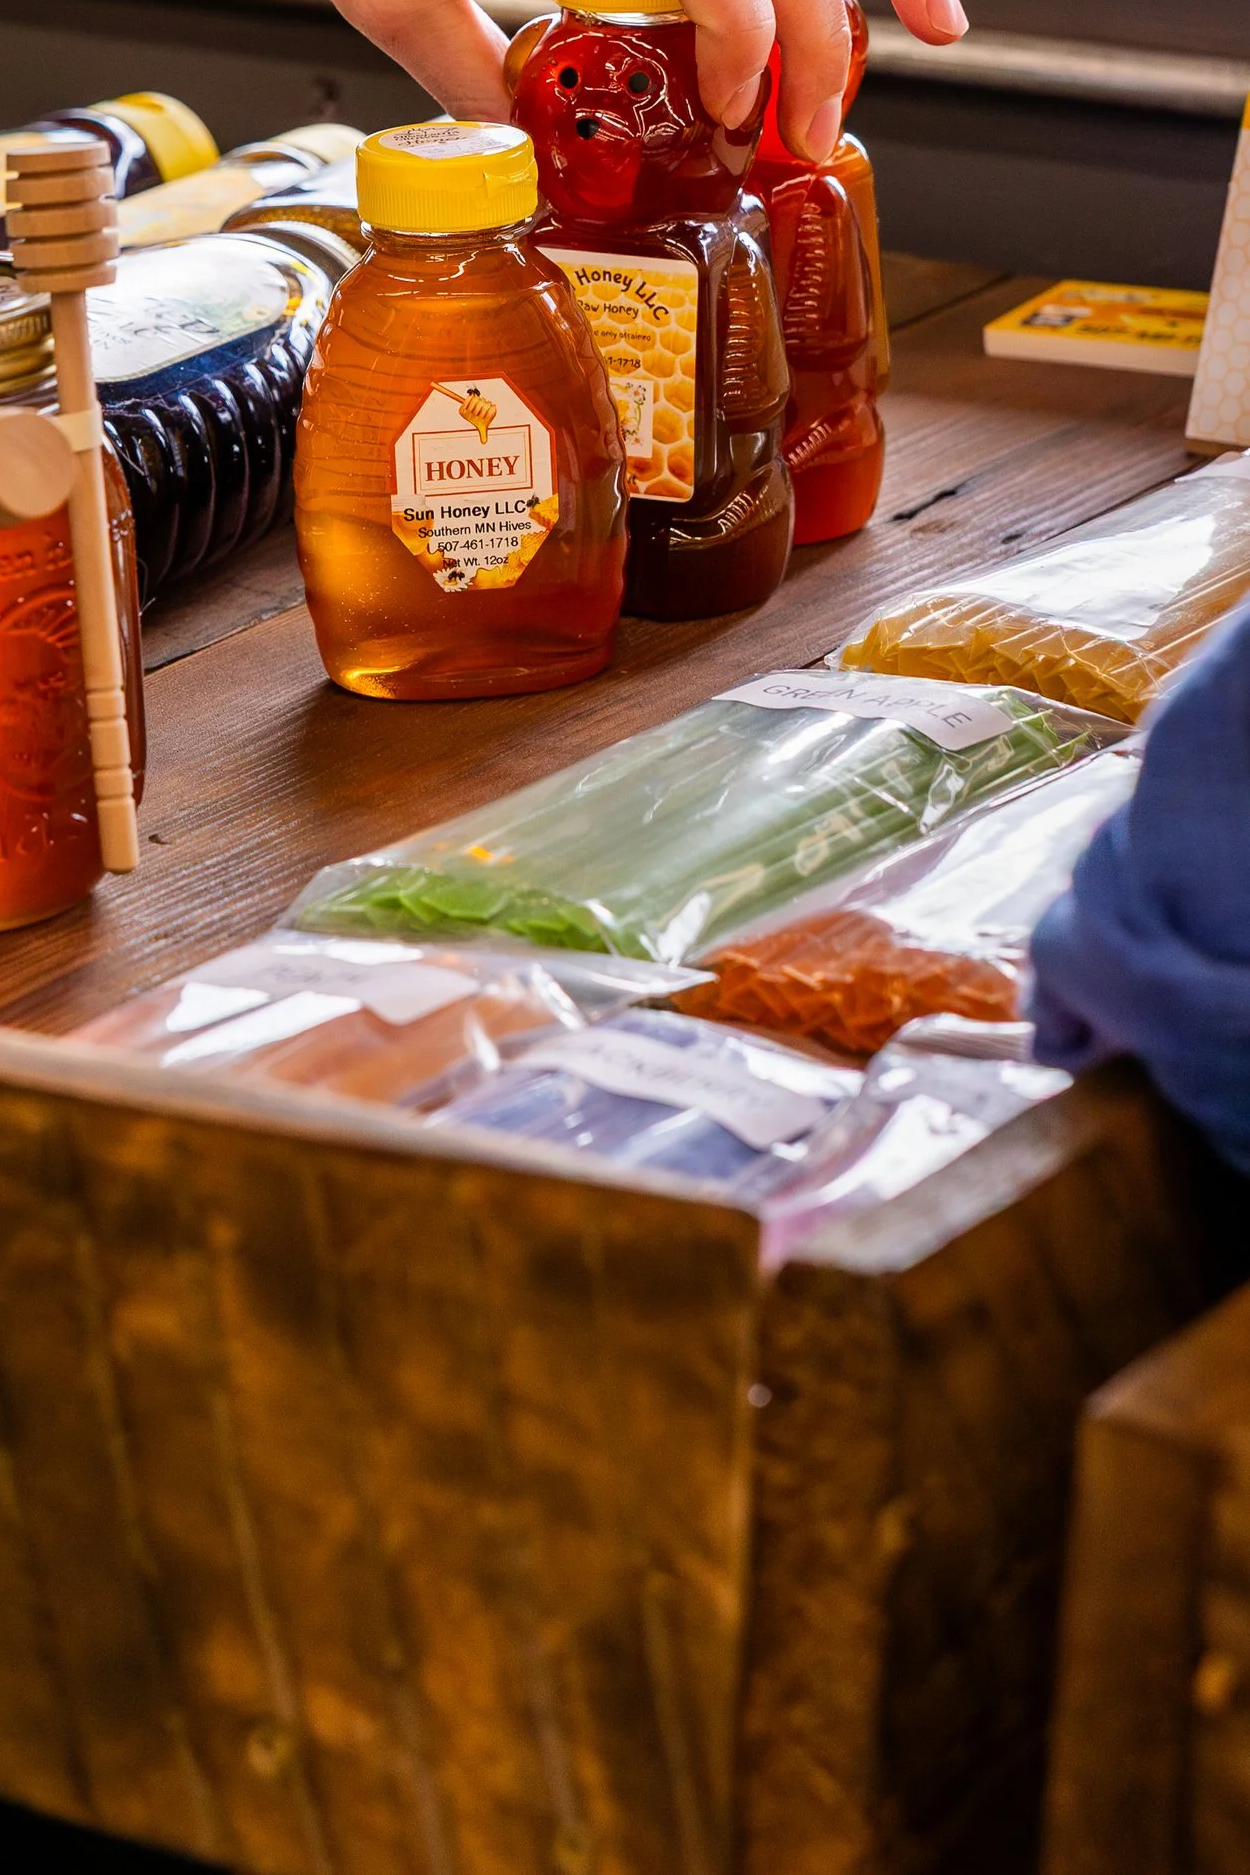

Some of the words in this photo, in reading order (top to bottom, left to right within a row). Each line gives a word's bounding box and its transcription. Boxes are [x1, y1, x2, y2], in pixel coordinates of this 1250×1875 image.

[575, 267, 633, 293] Honey
[635, 281, 670, 321] LLC
[603, 303, 640, 320] Honey
[424, 454, 520, 482] HONEY
[403, 507, 435, 522] Sun
[440, 504, 490, 521] Honey
[495, 499, 528, 516] LLC
[418, 526, 471, 539] Southern
[475, 522, 496, 534] MN
[499, 520, 532, 532] Hives
[437, 536, 519, 553] 507-461-1718
[442, 558, 461, 569] Net
[464, 556, 481, 567] Wt.
[484, 555, 510, 566] 12oz
[863, 694, 973, 729] APPLE
